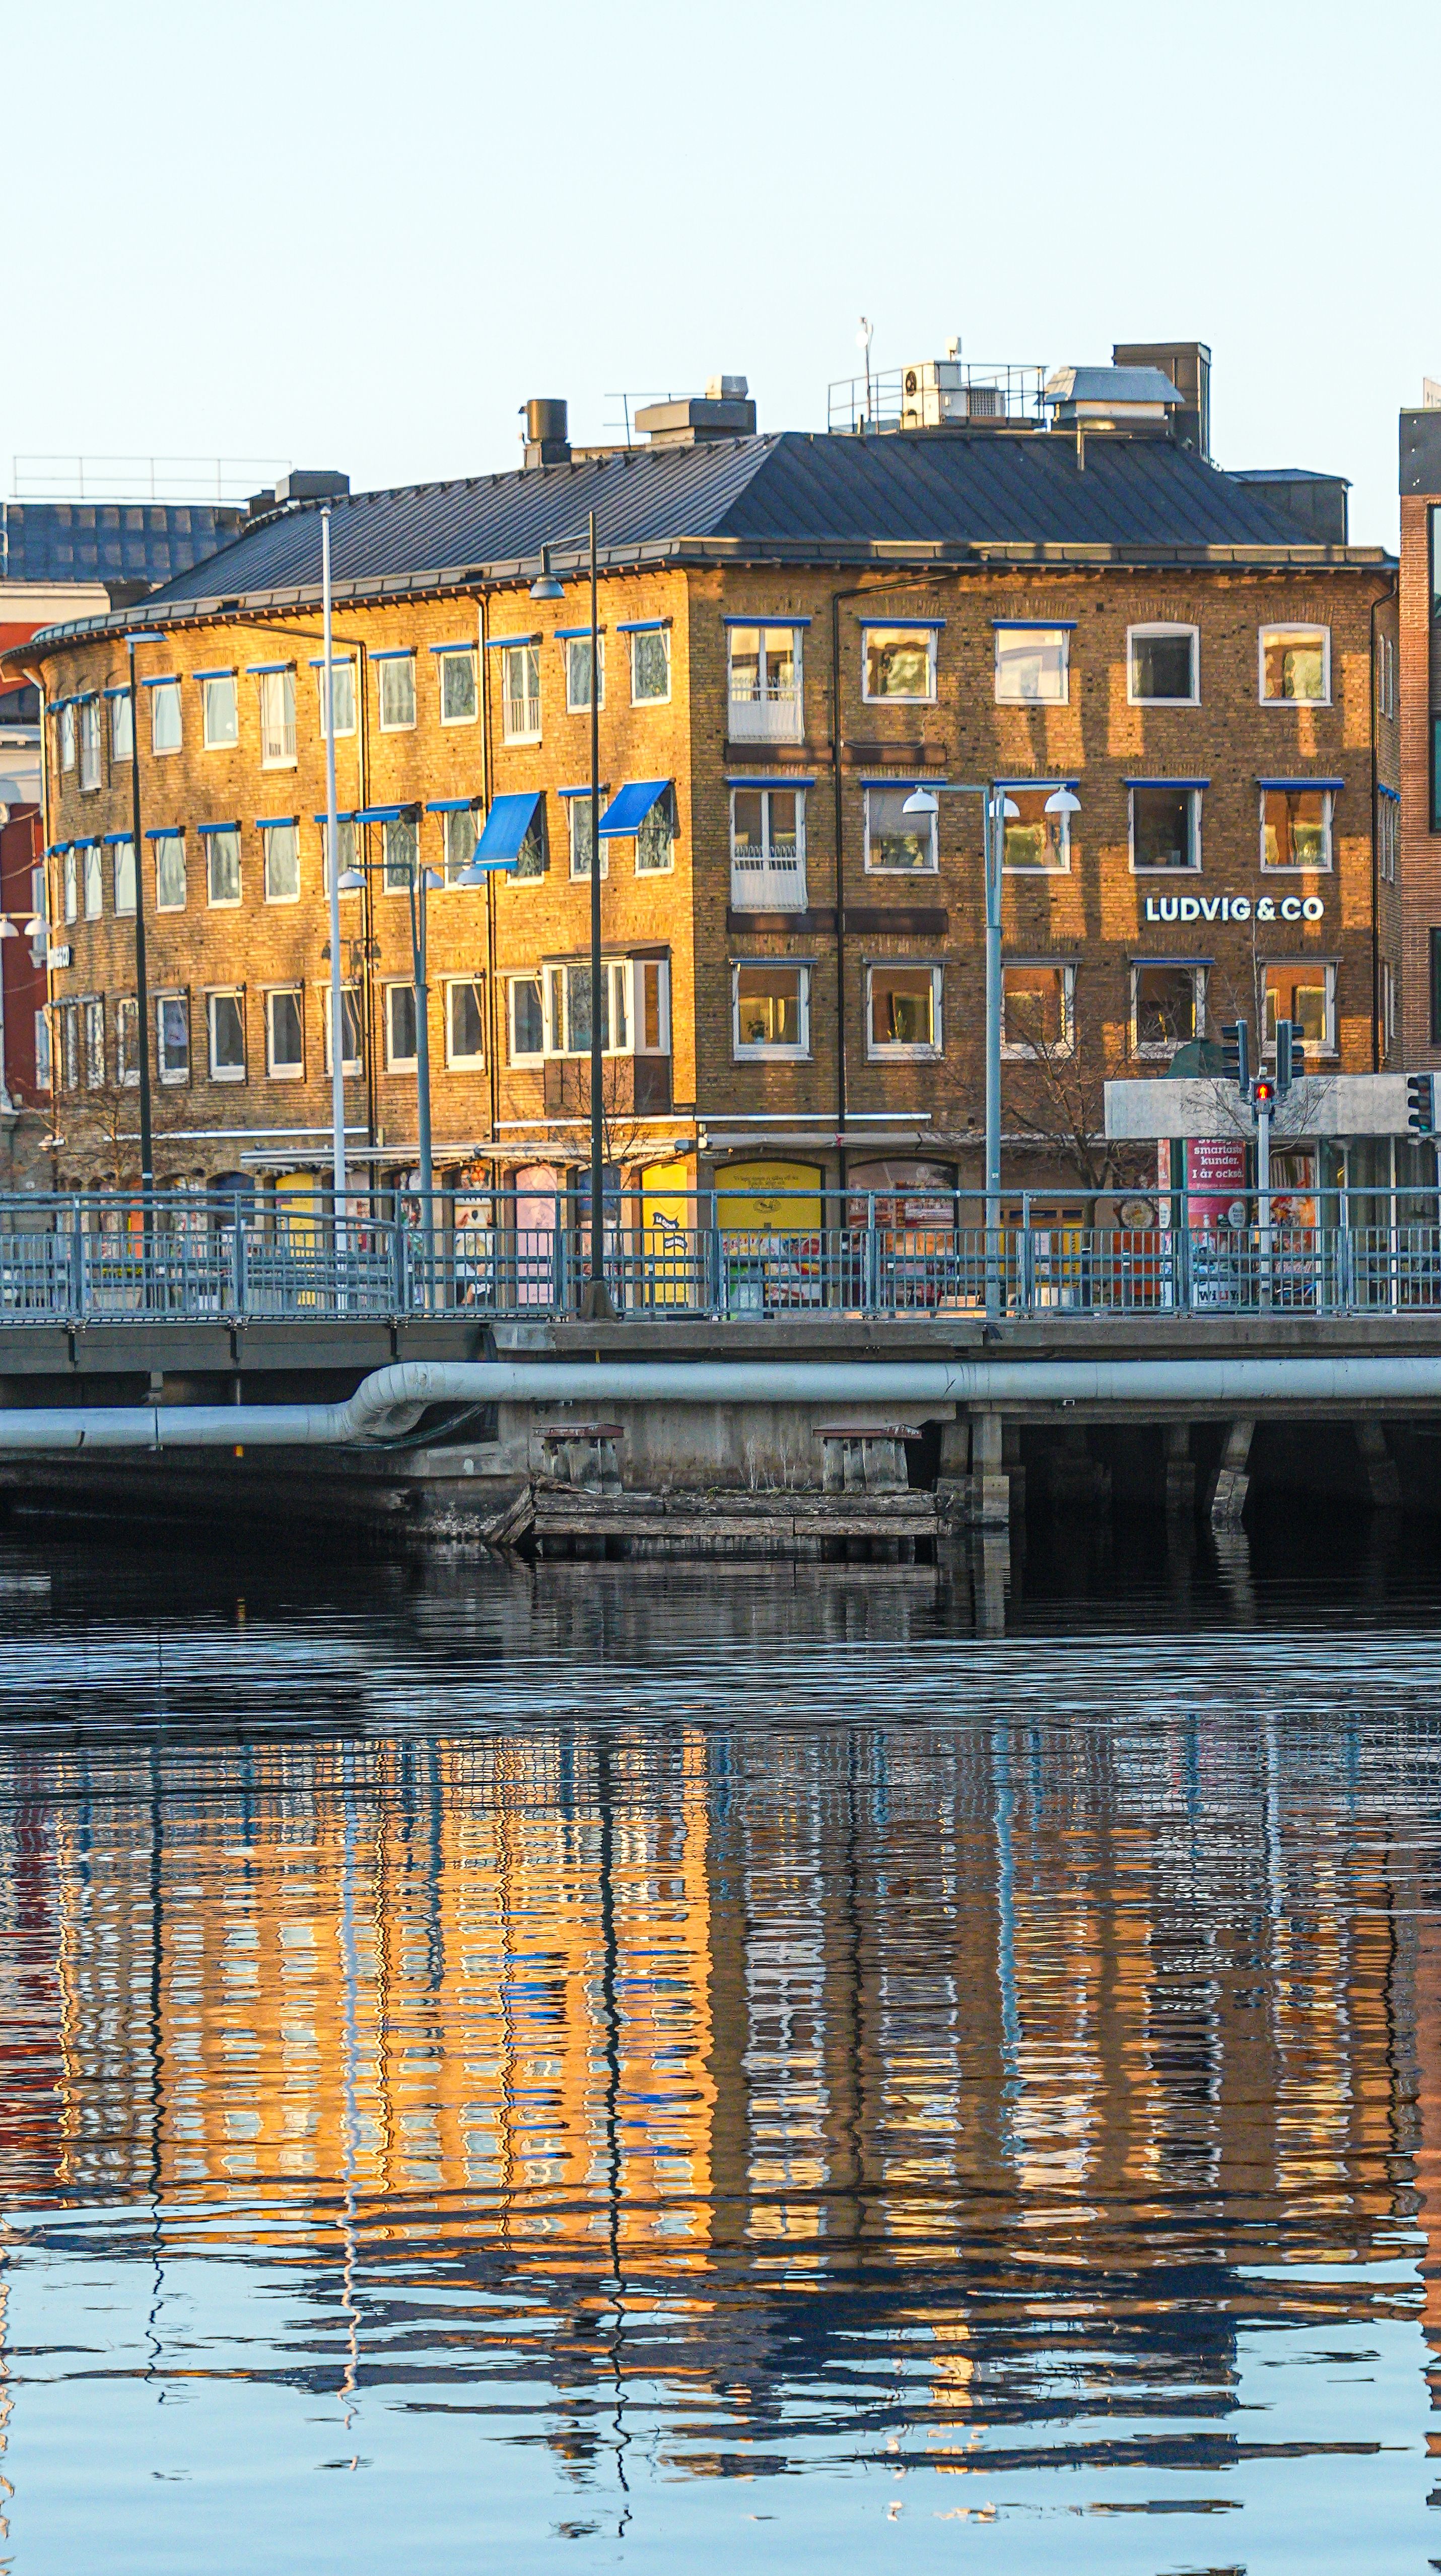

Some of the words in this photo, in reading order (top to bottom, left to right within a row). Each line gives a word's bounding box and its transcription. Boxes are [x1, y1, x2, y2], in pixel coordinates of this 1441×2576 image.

[1146, 897, 1251, 921] LUDVIG
[1257, 897, 1276, 921] &
[1281, 897, 1325, 921] CO
[1201, 1156, 1239, 1165] kunder.
[1192, 1169, 1198, 1178] I
